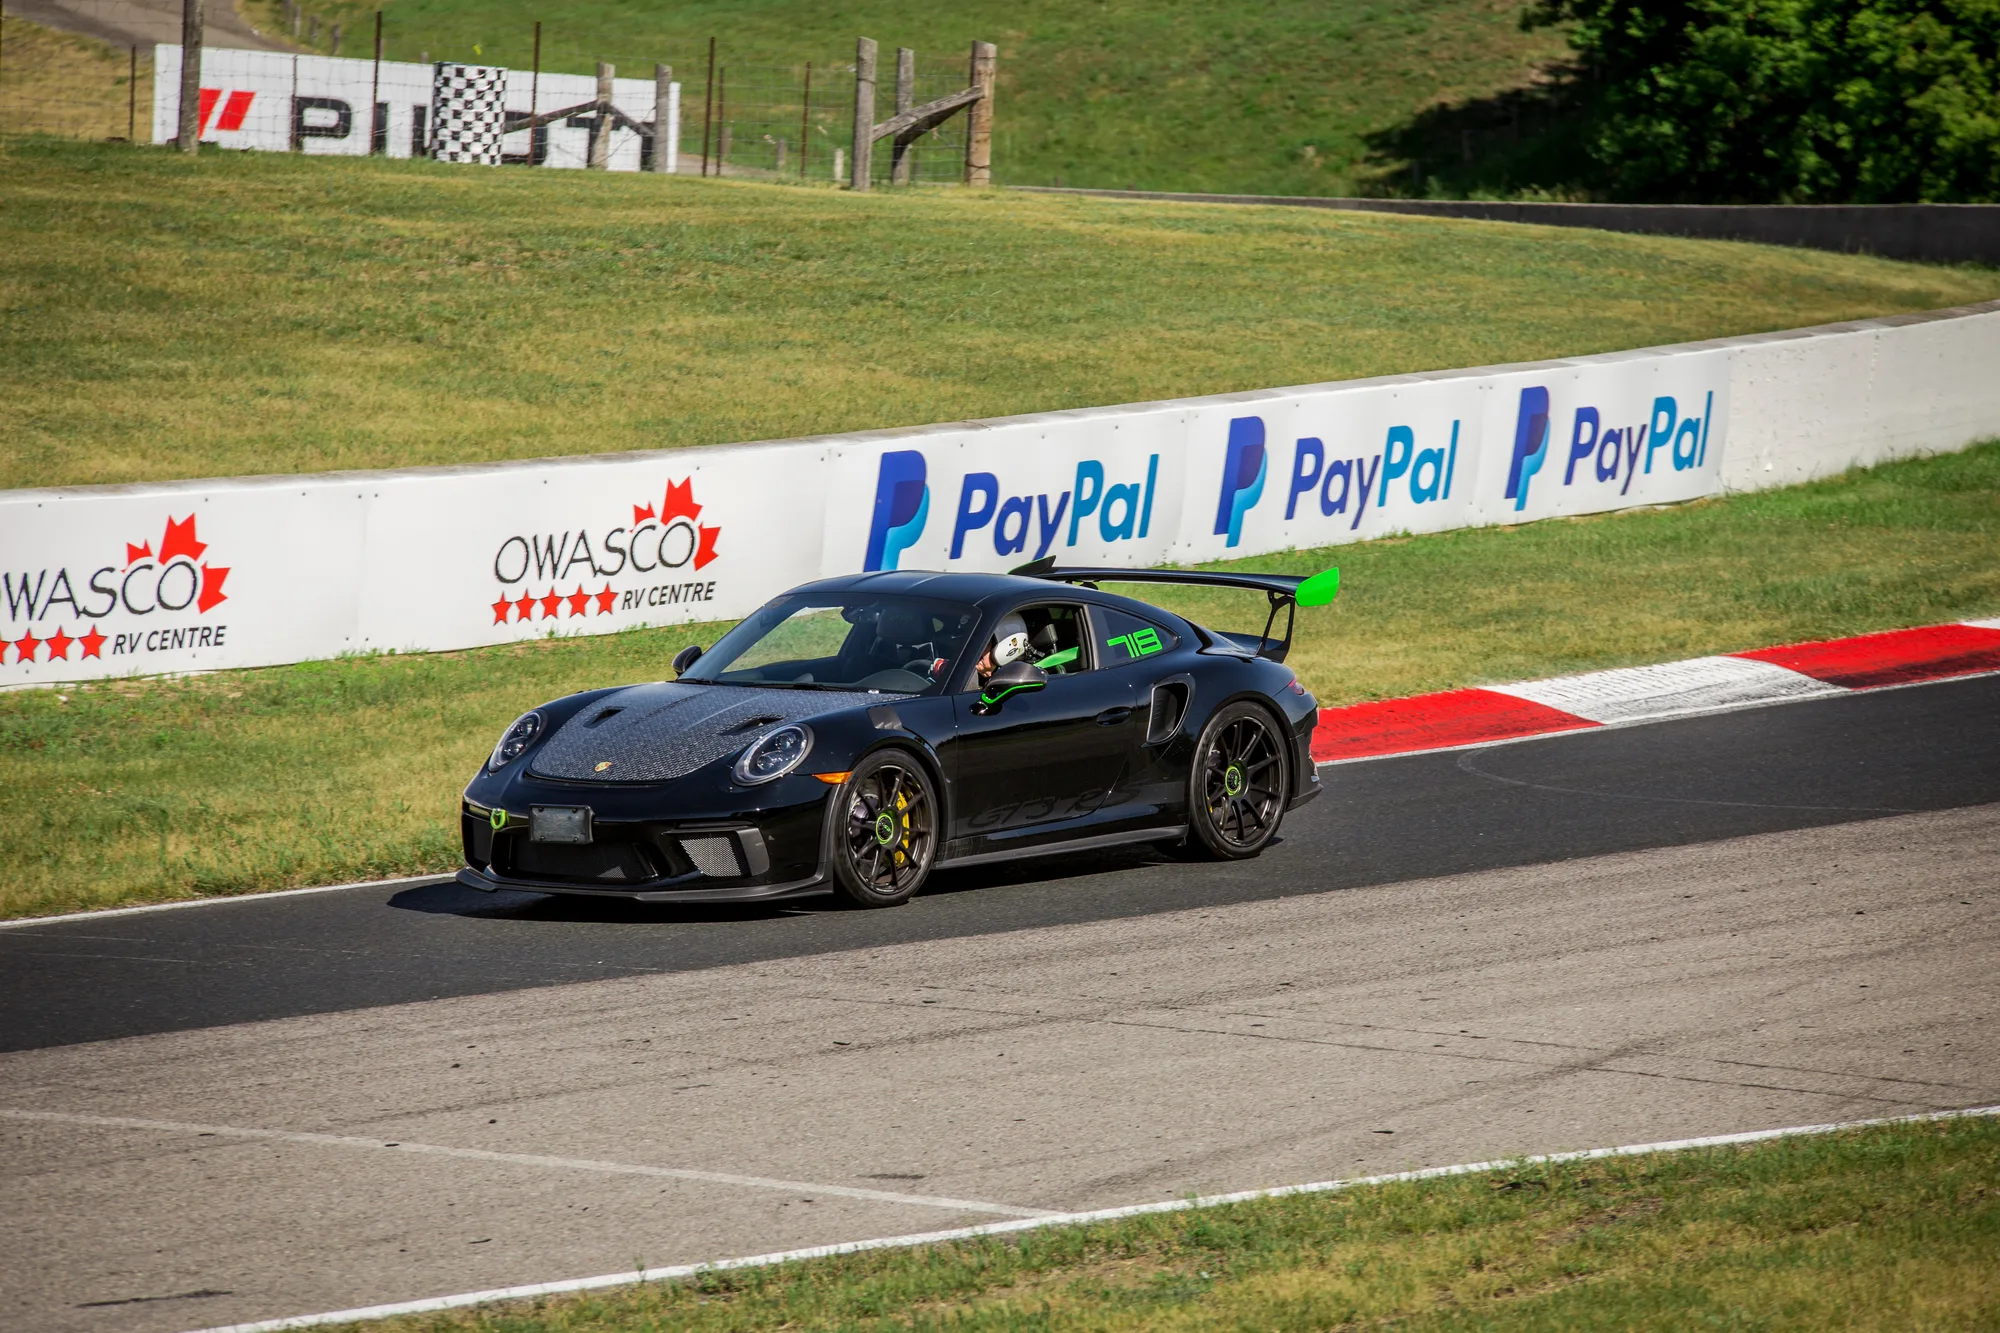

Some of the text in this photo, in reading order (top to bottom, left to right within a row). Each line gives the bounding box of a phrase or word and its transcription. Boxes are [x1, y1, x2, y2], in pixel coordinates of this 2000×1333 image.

[1563, 390, 1714, 496] PayPal
[1284, 419, 1460, 531] PayPal
[949, 453, 1160, 560] PayPal
[494, 521, 696, 584] OWASCO
[0, 560, 198, 622] WASCO
[621, 581, 717, 610] RV CENTRE
[112, 625, 227, 655] RV CENTRE
[967, 796, 1059, 829] GT3
